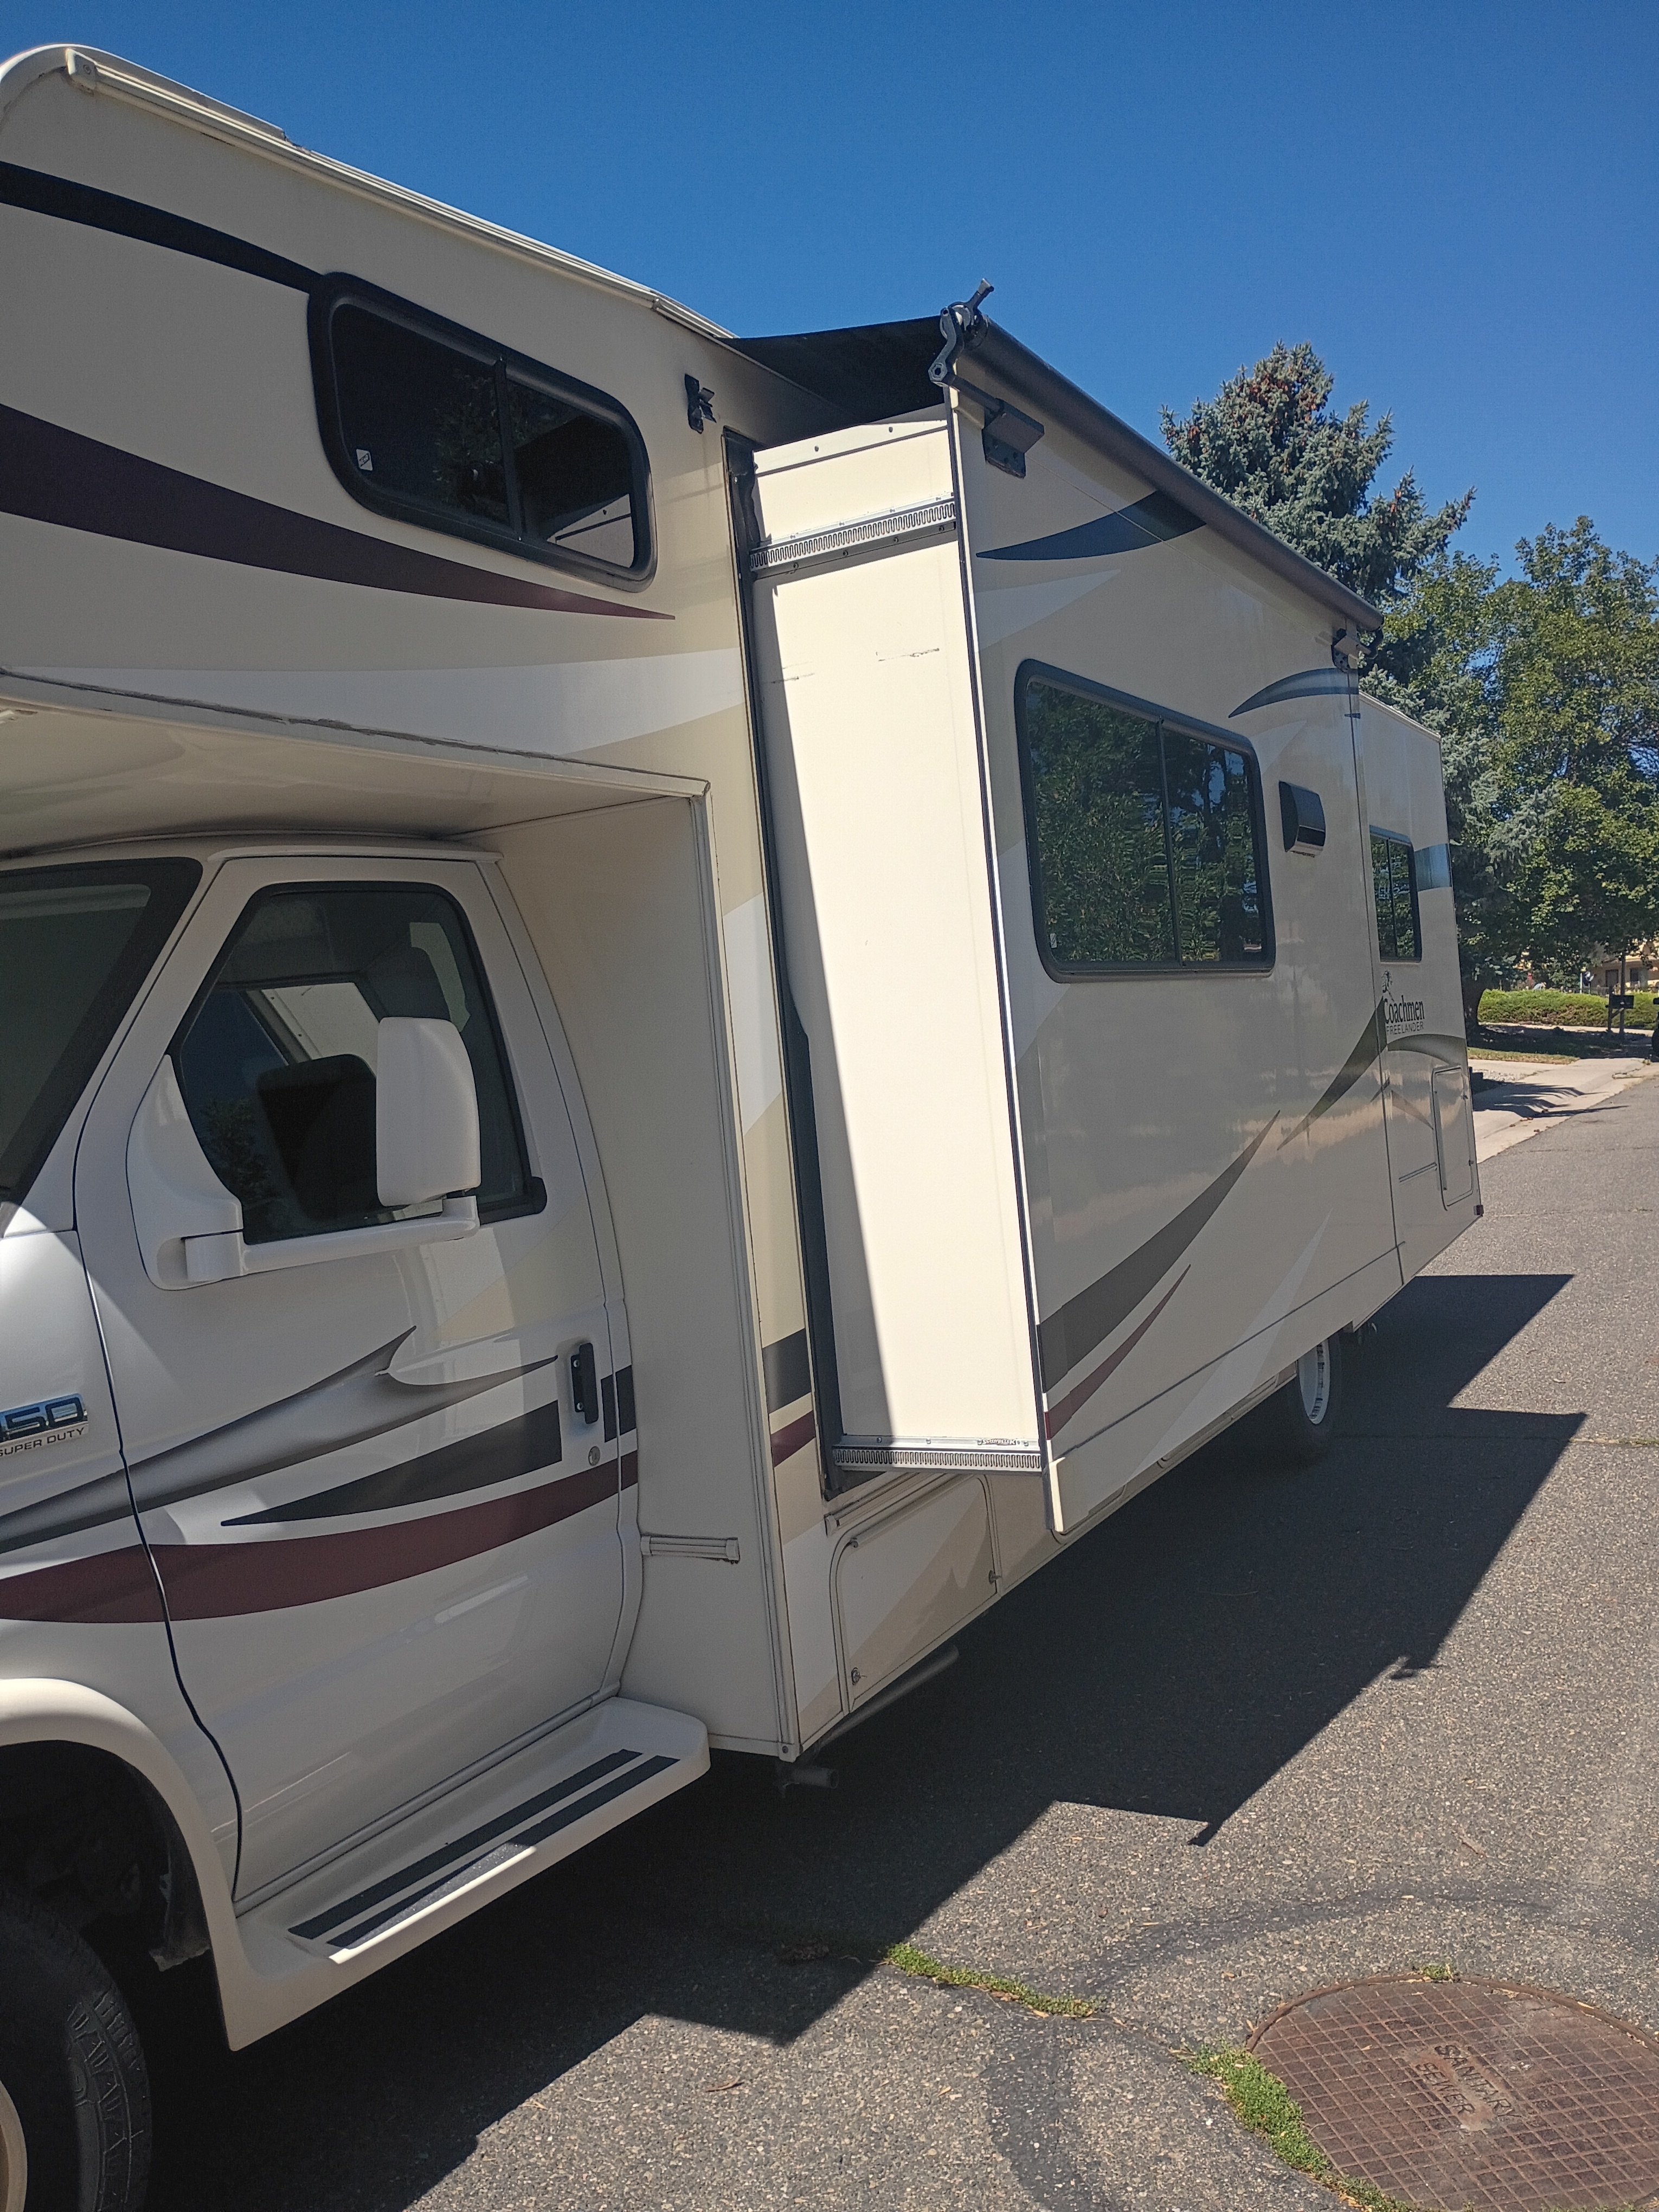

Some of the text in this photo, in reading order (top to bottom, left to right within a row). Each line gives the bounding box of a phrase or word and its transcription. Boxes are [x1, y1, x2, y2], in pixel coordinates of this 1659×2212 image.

[1384, 995, 1425, 1024] Coachmen
[1386, 1021, 1424, 1034] FREELANDER
[0, 1397, 83, 1441] 50
[47, 1427, 85, 1444] DUTY
[1415, 2062, 1475, 2114] SEWER
